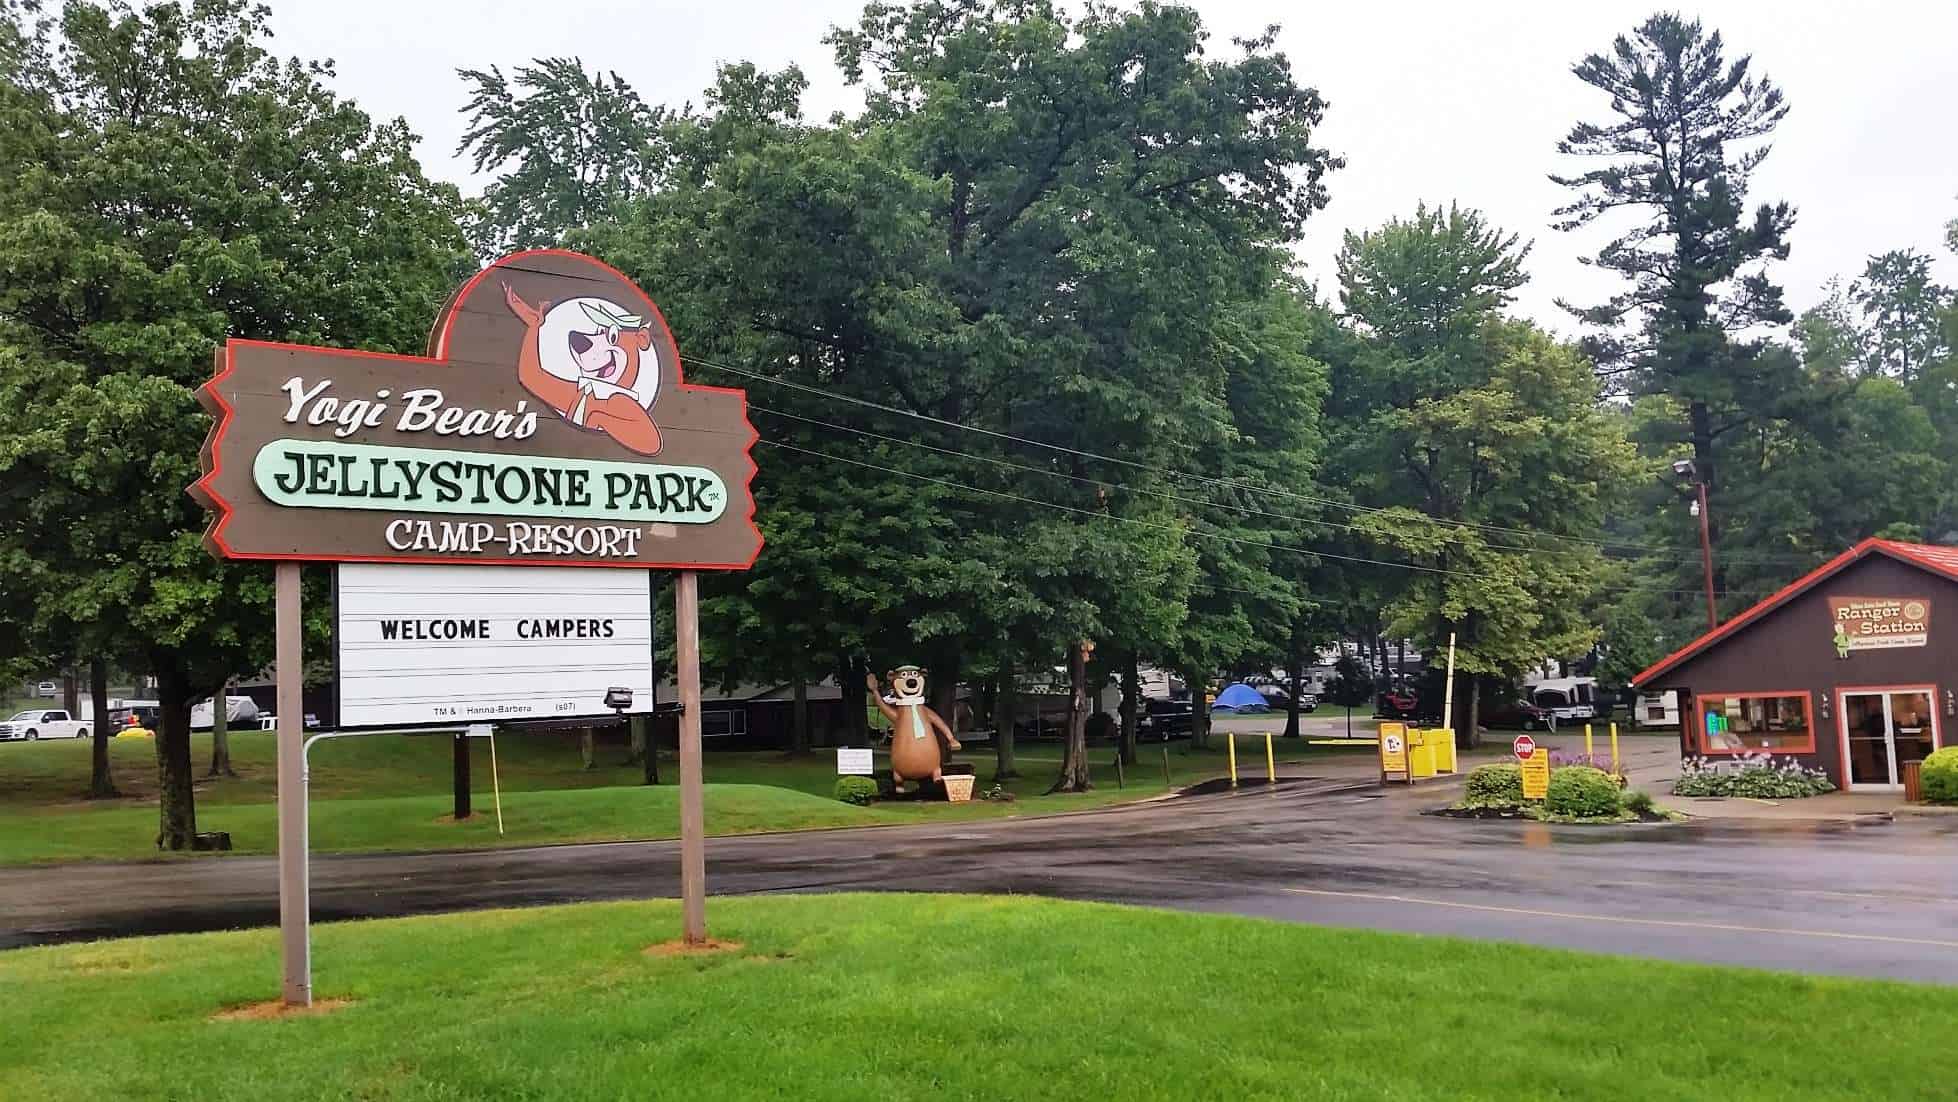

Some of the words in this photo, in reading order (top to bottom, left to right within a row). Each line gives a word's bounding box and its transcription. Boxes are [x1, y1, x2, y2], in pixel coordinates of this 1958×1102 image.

[281, 376, 390, 437] Yogi
[397, 388, 538, 439] Bear's
[274, 452, 592, 507] JELLYSTONE
[604, 474, 712, 513] PARK
[386, 519, 641, 557] CAMP-RESORT
[1837, 606, 1900, 621] Ranger
[381, 619, 491, 640] WELCOME
[516, 618, 615, 639] CAMPERS
[1860, 620, 1925, 634] Station
[1516, 743, 1533, 753] STOP
